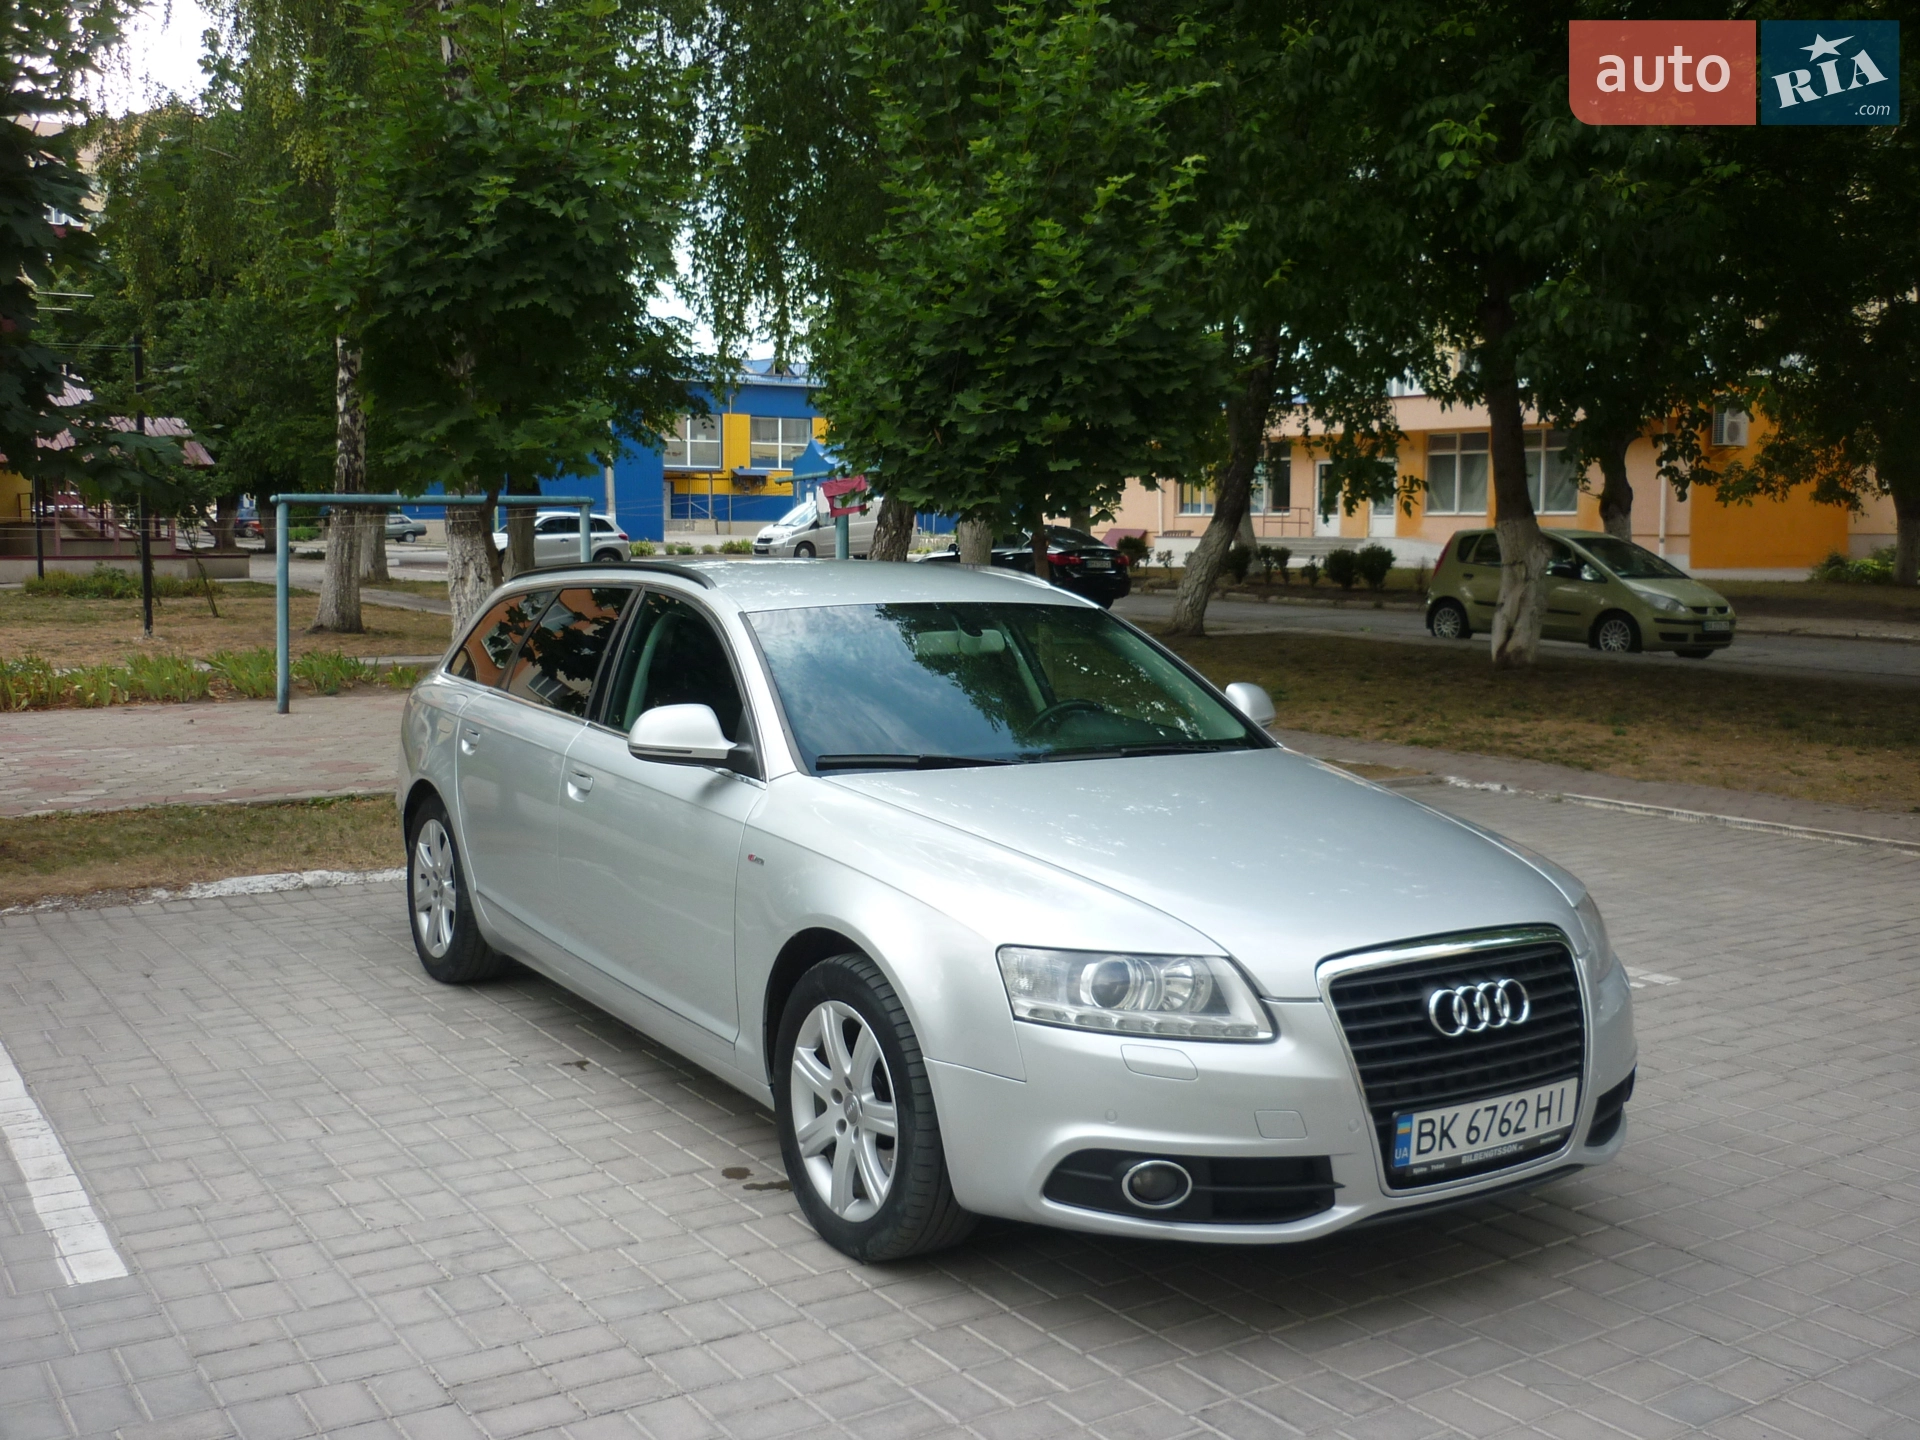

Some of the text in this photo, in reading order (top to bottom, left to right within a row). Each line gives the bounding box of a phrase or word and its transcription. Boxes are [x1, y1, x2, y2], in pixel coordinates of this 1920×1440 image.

[1415, 1087, 1565, 1156] BK 6762 HI
[1394, 1147, 1409, 1159] UA
